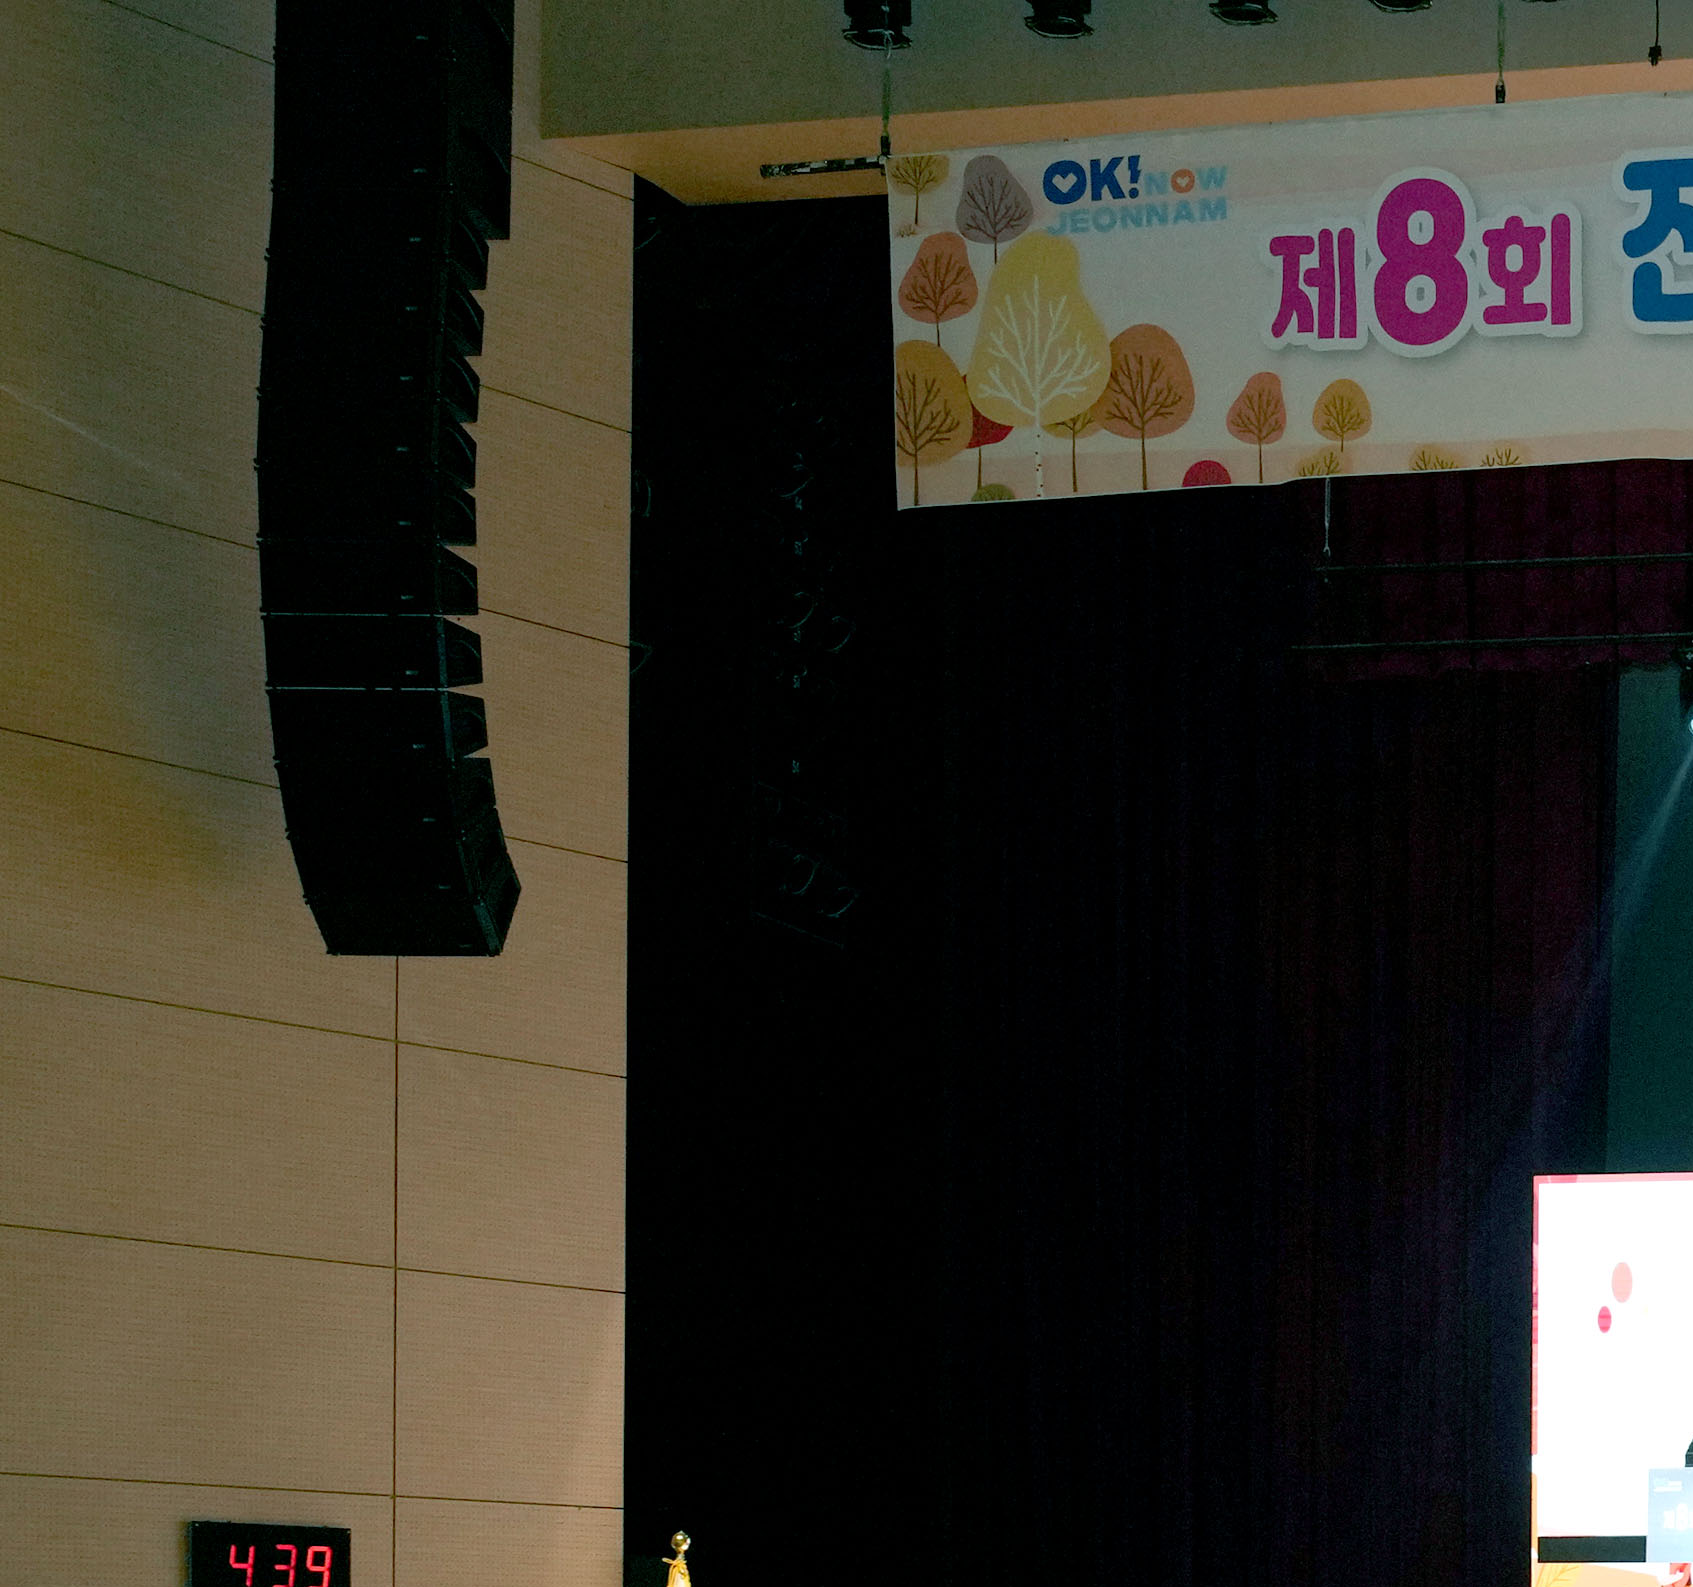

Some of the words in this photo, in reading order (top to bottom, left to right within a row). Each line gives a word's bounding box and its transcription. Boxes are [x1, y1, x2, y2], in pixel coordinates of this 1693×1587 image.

[1043, 155, 1141, 205] OK!
[1047, 196, 1228, 236] JEONNAM
[1269, 177, 1572, 346] 제8회
